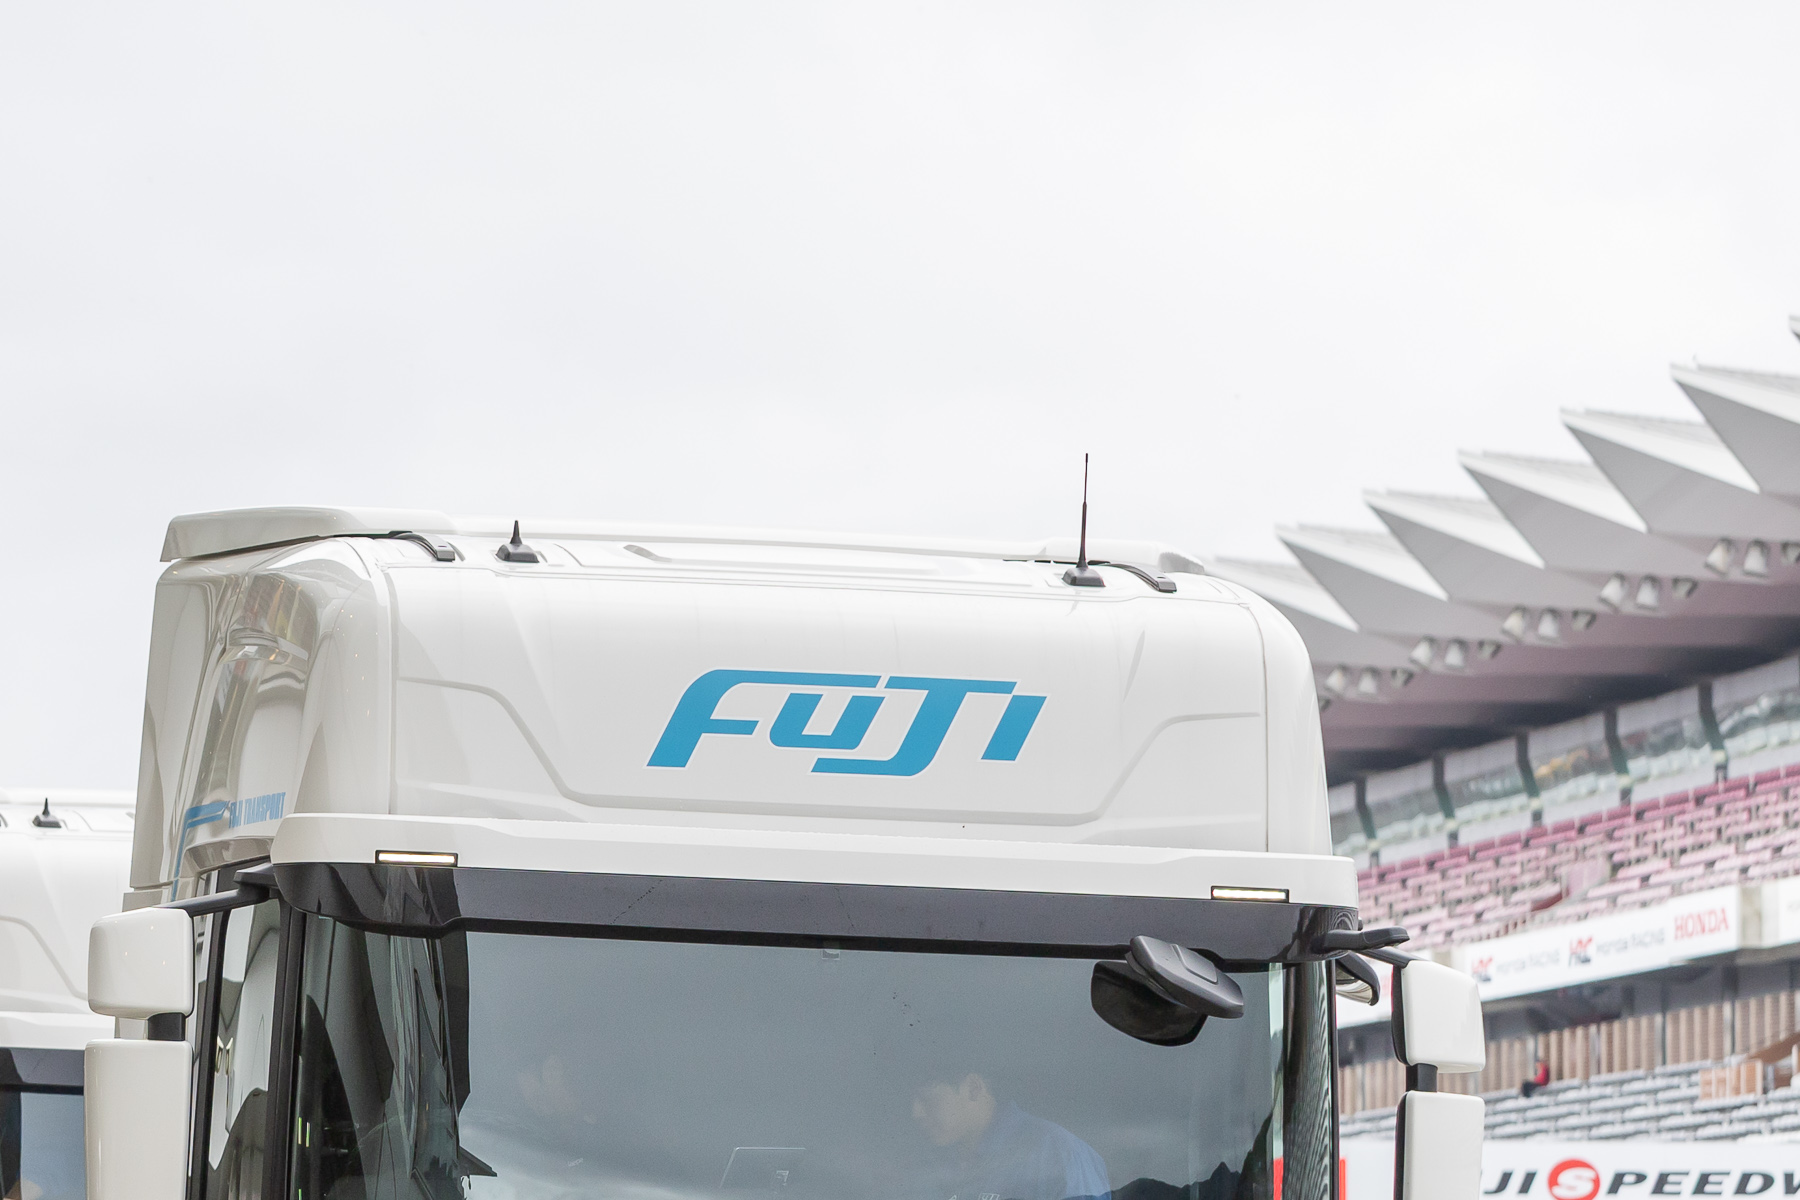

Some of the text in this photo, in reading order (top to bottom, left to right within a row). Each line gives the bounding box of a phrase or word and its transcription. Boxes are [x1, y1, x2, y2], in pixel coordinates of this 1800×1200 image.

[645, 668, 1049, 778] FUJI
[1674, 907, 1729, 941] HONDA
[1481, 1171, 1538, 1195] JI
